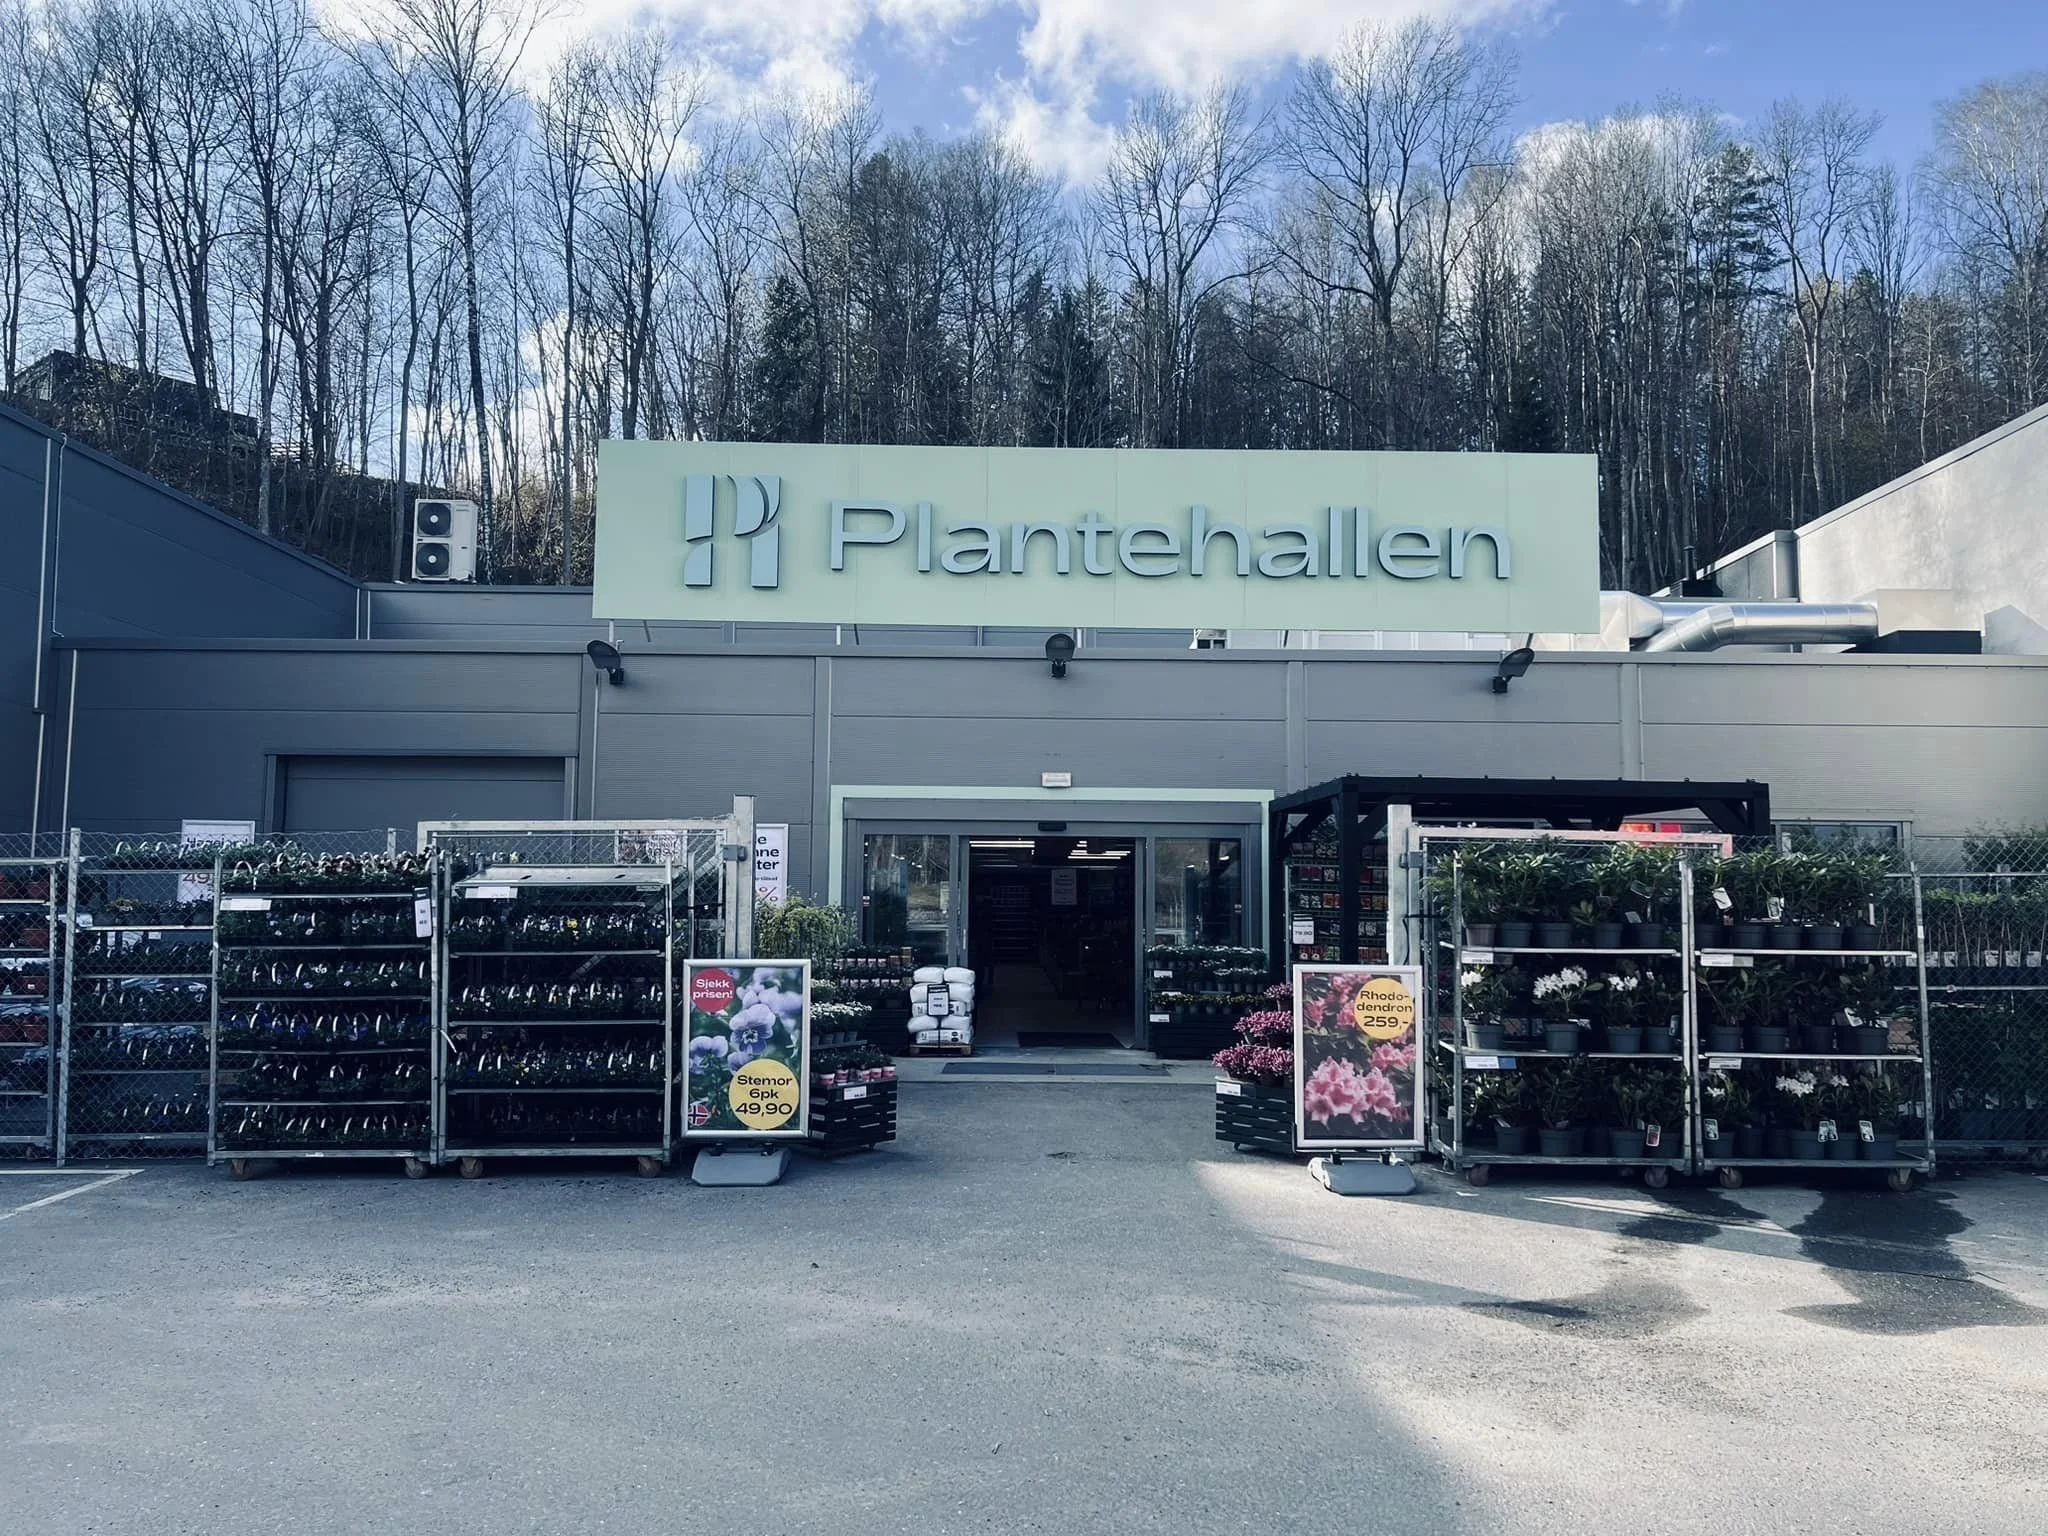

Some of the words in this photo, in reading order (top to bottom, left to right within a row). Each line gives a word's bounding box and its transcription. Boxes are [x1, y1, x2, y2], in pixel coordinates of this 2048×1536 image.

[830, 500, 1512, 579] Plantehallen
[756, 860, 780, 870] ter
[696, 978, 730, 989] Sjekk
[692, 990, 734, 1000] prisen!
[1360, 990, 1409, 1001] Rhodo-
[1356, 1002, 1413, 1013] dendron
[1363, 1015, 1409, 1030] 259,-
[737, 1074, 793, 1086] Stemor
[749, 1088, 779, 1101] 6pk
[735, 1102, 793, 1117] 49,90
